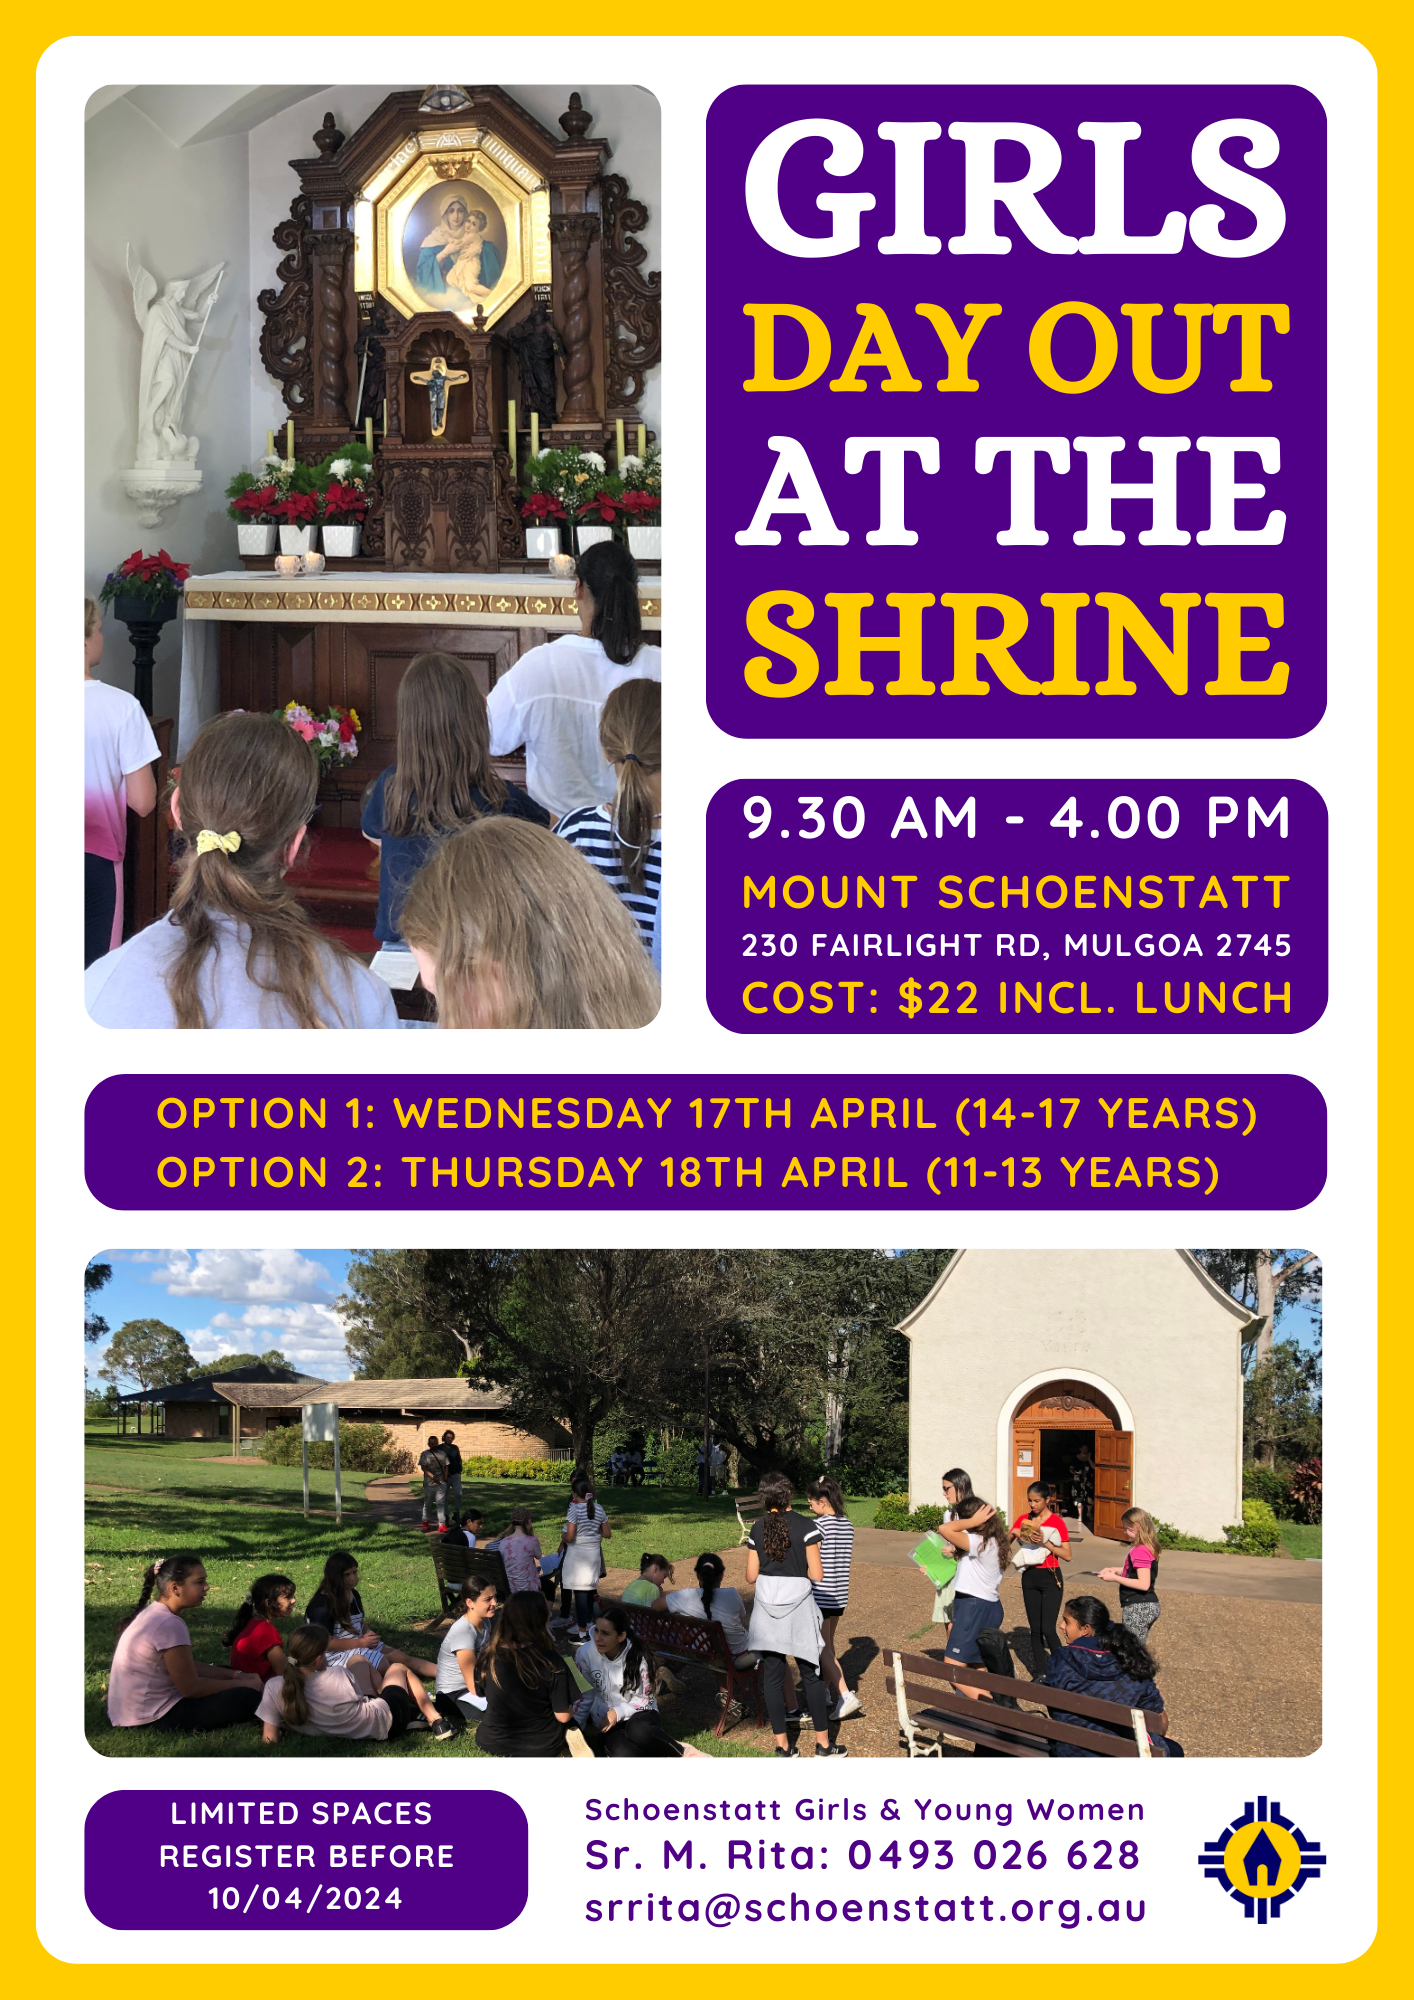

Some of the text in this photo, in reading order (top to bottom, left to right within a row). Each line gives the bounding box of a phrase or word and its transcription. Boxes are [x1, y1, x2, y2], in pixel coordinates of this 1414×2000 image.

[745, 118, 1286, 258] GIRLS
[743, 301, 1290, 394] DAY OUT
[735, 436, 1286, 546] AT THE
[744, 590, 1290, 698] SHRINE
[743, 796, 1288, 839] 9.30 AM - 4.00 PM
[744, 875, 1290, 909] MOUNT SCHOENSTATT
[742, 934, 1290, 960] 230 FAIRLIGHT RD, MULGOA 2745
[743, 977, 1290, 1019] COST: $22 INCL. LUNCH
[157, 1097, 1256, 1136] OPTION 1: WEDNESDAY 17TH APRIL (14-17 YEARS)
[157, 1156, 1218, 1195] OPTION 2: THURSDAY 18TH APRIL (11-13 YEARS)
[172, 1802, 431, 1825] LIMITED SPACES
[586, 1798, 1143, 1826] Schoenstatt Girls & Young Women
[161, 1845, 453, 1868] REGISTER BEFORE
[586, 1839, 1139, 1870] Sr. M. Rita: 0493 026 628
[209, 1884, 402, 1913] 10/04/2024
[586, 1892, 1145, 1929] srrita@schoenstatt.org.au
